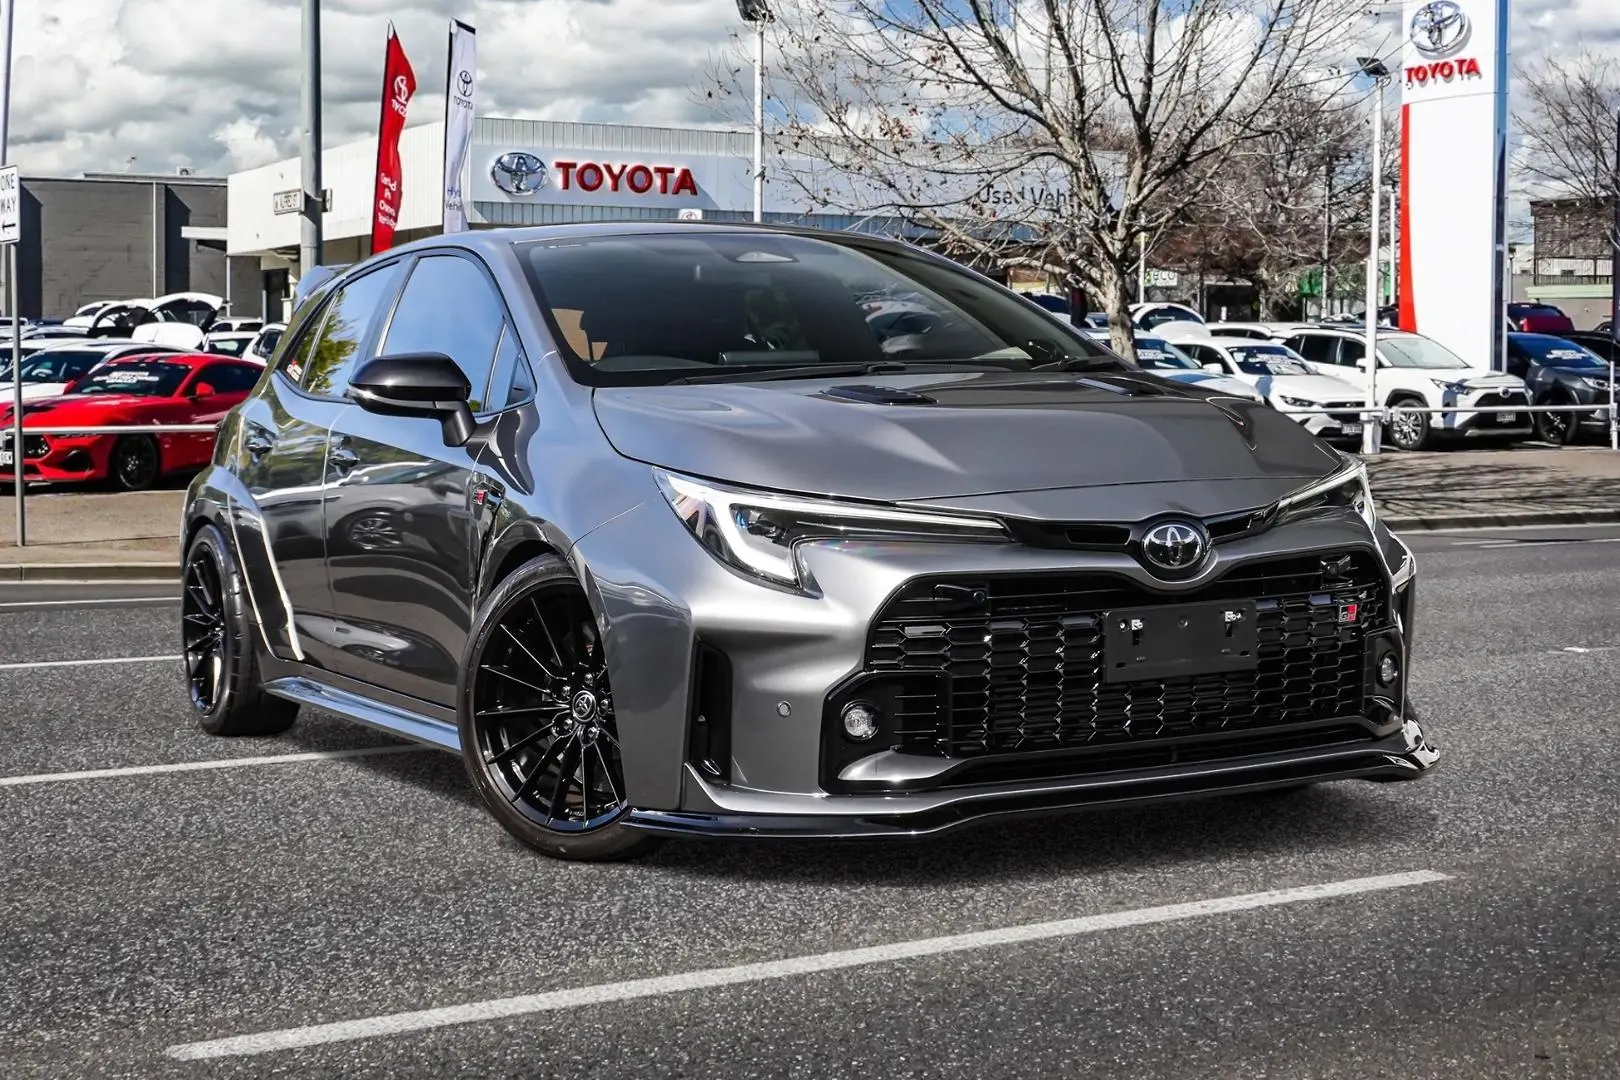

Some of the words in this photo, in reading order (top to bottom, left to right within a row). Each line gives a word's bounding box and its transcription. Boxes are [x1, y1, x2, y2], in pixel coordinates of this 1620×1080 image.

[1404, 58, 1482, 83] TOYOTA
[1, 172, 16, 191] ONE
[554, 161, 699, 196] TOYOTA
